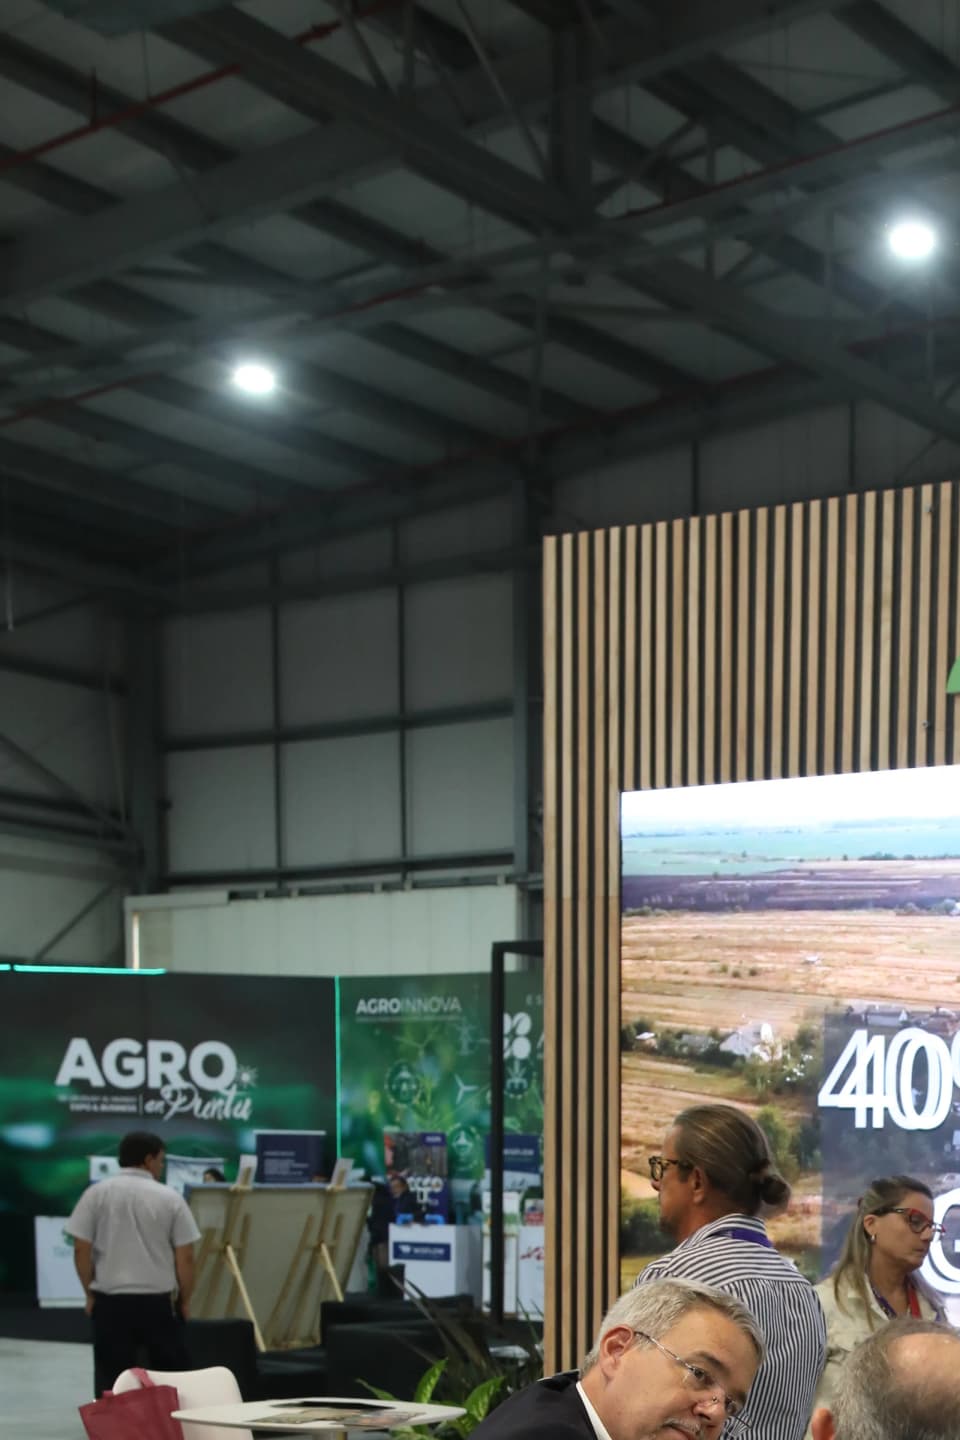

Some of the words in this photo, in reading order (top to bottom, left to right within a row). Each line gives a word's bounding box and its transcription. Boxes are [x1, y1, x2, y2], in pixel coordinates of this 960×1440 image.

[355, 997, 463, 1015] AGROINNOVA
[54, 1037, 238, 1091] AGRO
[160, 1081, 252, 1121] Punta
